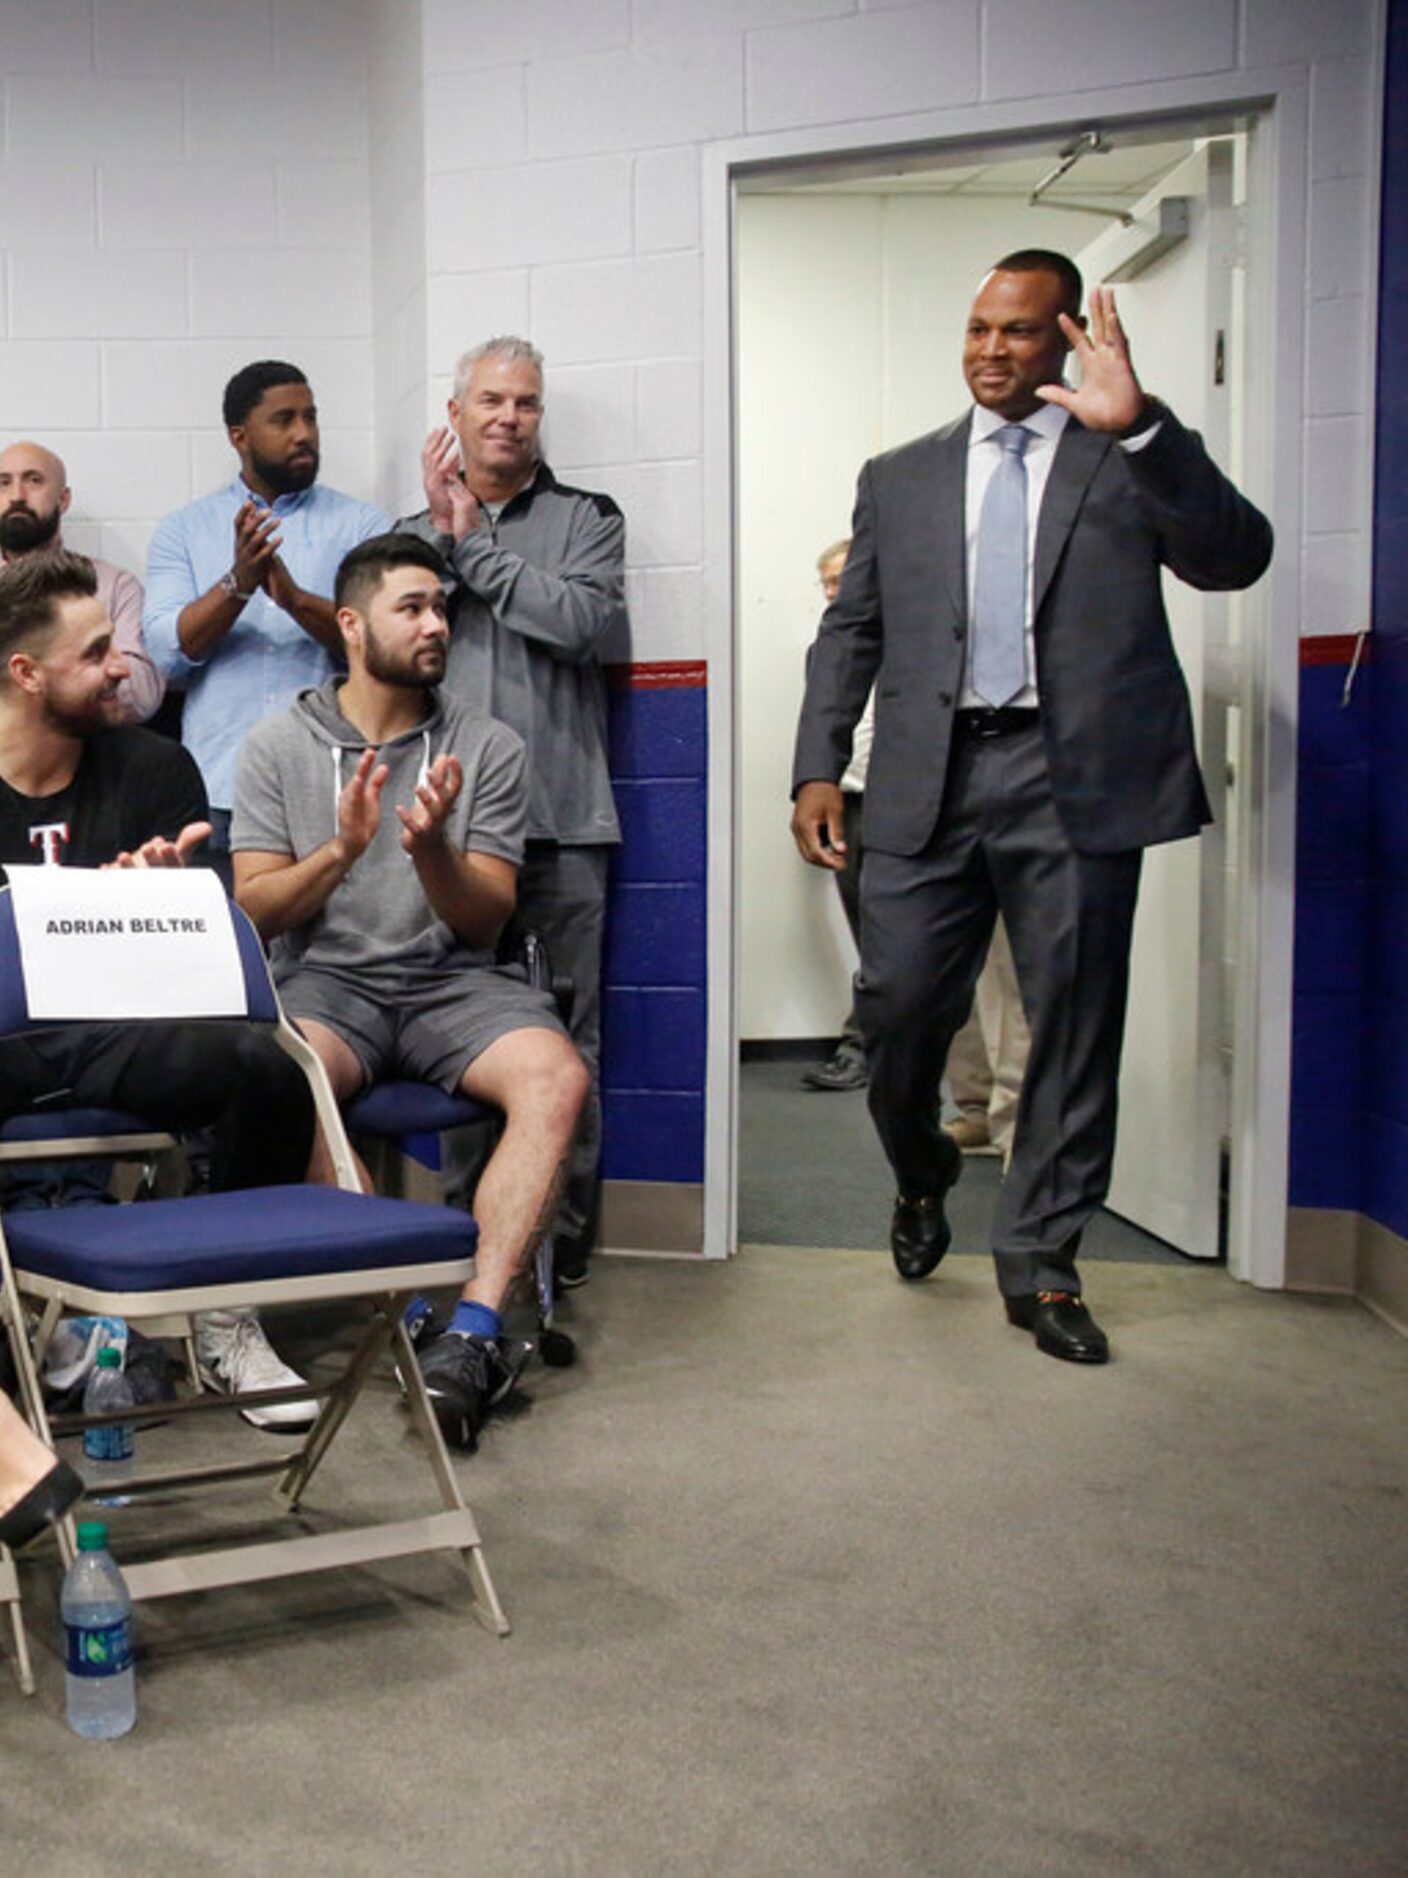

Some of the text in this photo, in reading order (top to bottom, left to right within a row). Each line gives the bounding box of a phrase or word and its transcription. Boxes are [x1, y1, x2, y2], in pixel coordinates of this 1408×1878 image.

[28, 821, 70, 867] T
[45, 917, 208, 935] ADRIAN BELTRE
